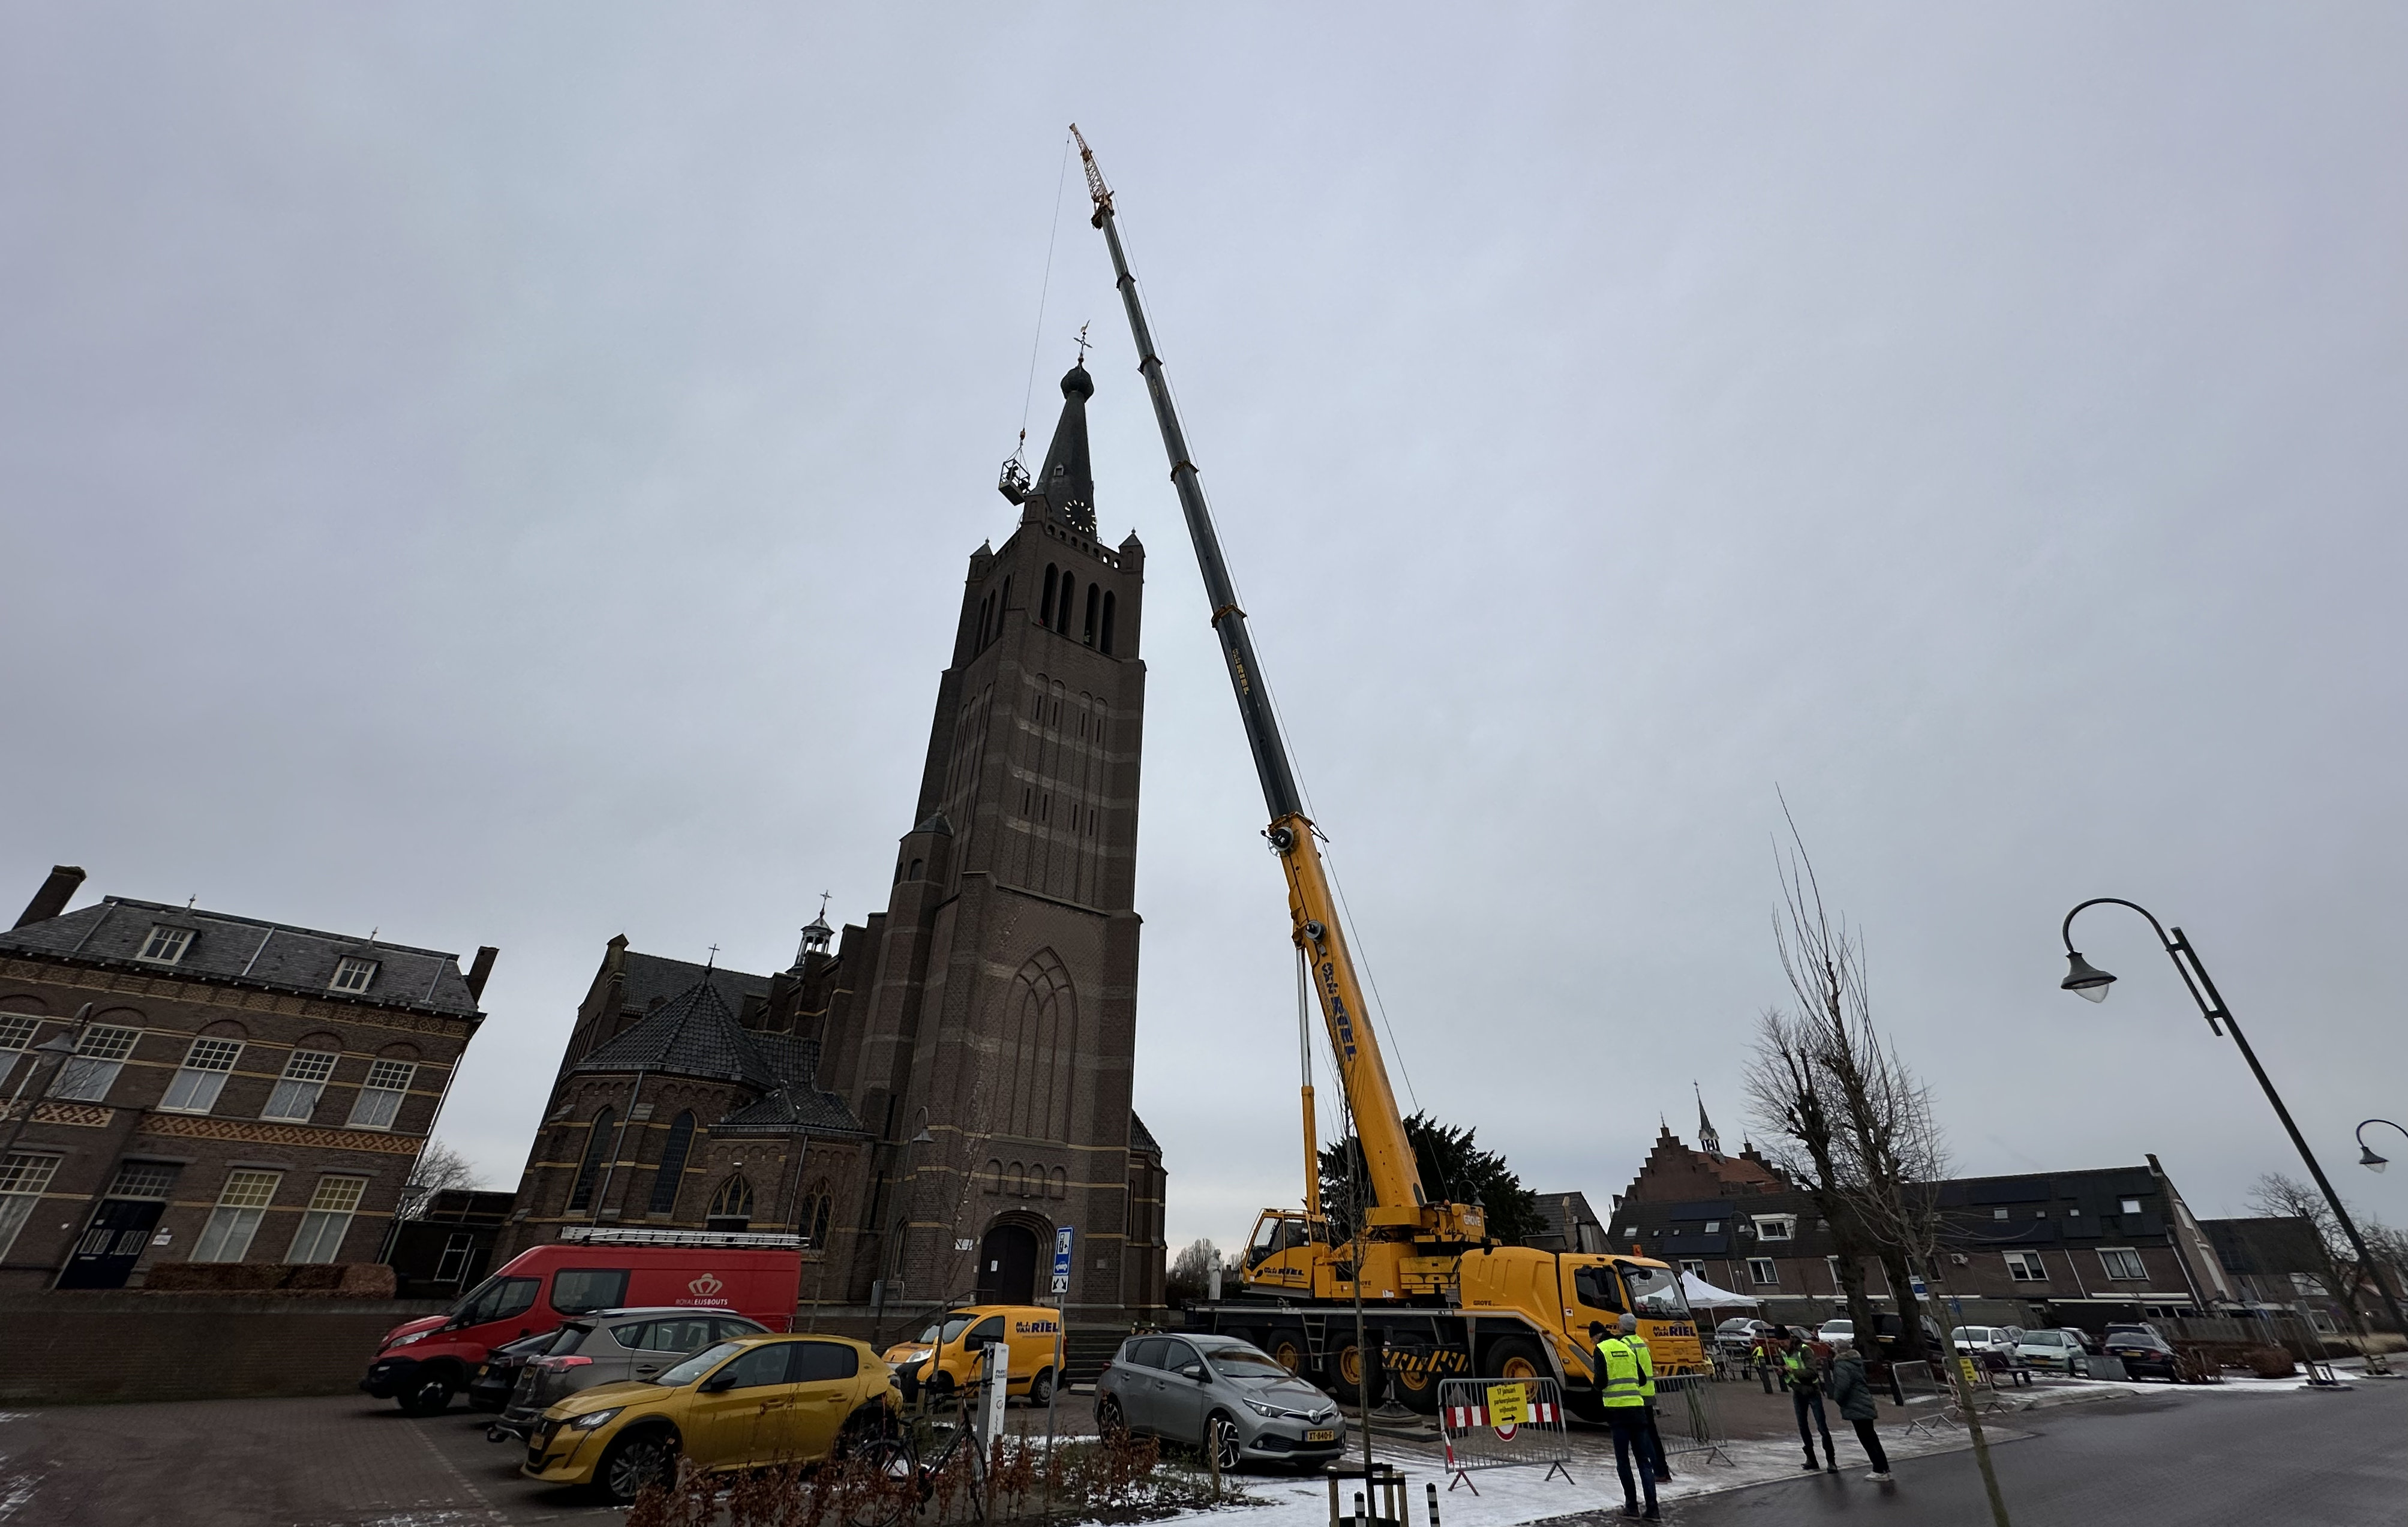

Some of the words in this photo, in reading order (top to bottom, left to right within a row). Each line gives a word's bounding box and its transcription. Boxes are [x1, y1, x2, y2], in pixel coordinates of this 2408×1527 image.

[1236, 664, 1249, 695] RIEL
[1322, 963, 1334, 994] VAN
[1331, 996, 1356, 1061] RIEL
[1464, 1215, 1481, 1227] GROVE
[1032, 1322, 1058, 1333] RIEL
[1669, 1326, 1696, 1337] RIEL
[1502, 1386, 1515, 1396] januari
[1494, 1397, 1520, 1406] parkeerplaatsen
[1310, 1431, 1332, 1440] XT-840-F
